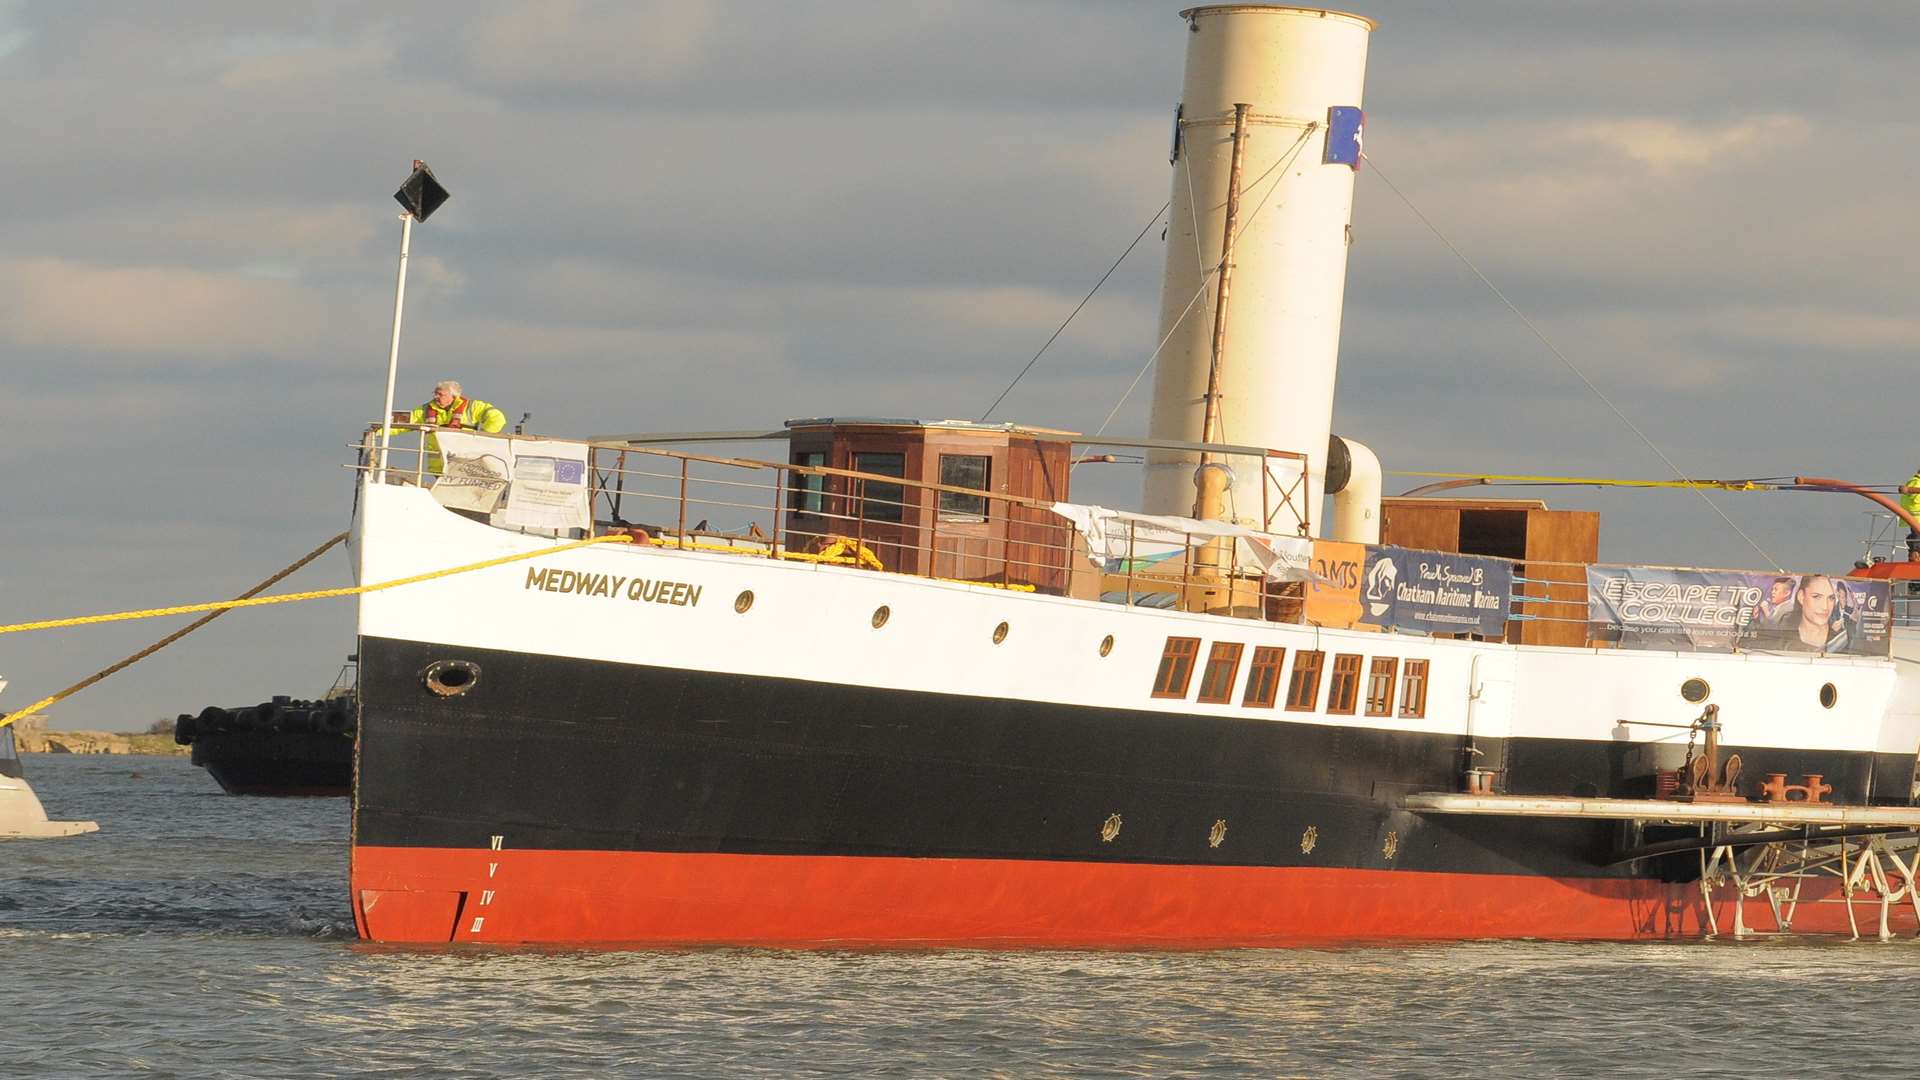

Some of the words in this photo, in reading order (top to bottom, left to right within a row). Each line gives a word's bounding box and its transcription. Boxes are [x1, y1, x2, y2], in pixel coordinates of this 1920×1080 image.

[525, 566, 626, 599] MEDWAY
[627, 578, 703, 607] QUEEN
[1396, 582, 1435, 604] Chatham
[1603, 577, 1723, 604] ESCAPE
[1727, 585, 1763, 607] TO
[1619, 600, 1754, 626] COLLEGE
[1641, 626, 1657, 634] you
[491, 835, 504, 851] VI
[489, 863, 498, 878] V
[480, 890, 495, 905] IV
[470, 917, 485, 933] III
